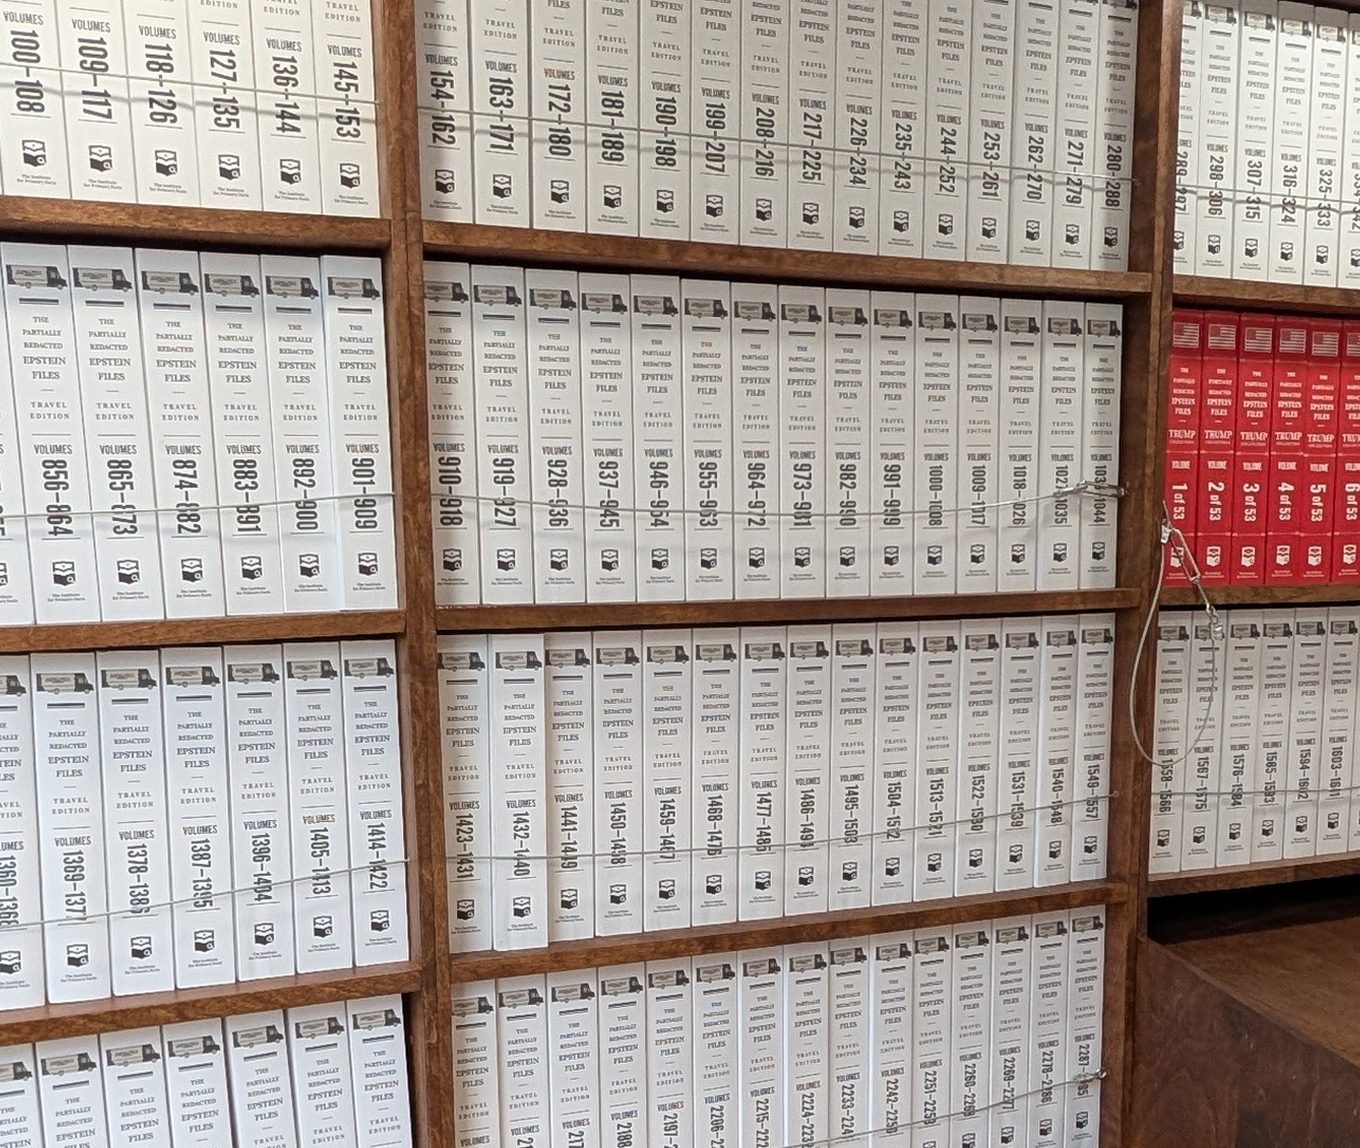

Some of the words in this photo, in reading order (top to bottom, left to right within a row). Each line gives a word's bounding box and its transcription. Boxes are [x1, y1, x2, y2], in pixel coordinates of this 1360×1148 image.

[2, 10, 45, 26] VOLUMES
[703, 5, 732, 18] EPSTEIN
[704, 20, 729, 32] FILES
[701, 47, 730, 60] TRAVEL
[8, 28, 46, 115] 100-108
[701, 61, 731, 73] EDITION
[77, 37, 114, 121] 109-117
[208, 48, 242, 131] 127-135
[700, 86, 731, 101] VOLUMES
[330, 61, 363, 141] 145-153
[428, 68, 457, 147] 154-162
[545, 82, 573, 158] 172-180
[653, 95, 678, 170] 190-198
[702, 101, 728, 174] 199-207
[799, 113, 822, 183] 217-225
[981, 131, 1001, 198] 253-261
[338, 360, 378, 372] EPSTEIN
[346, 373, 373, 385] FILES
[343, 402, 377, 413] TRAVEL
[343, 413, 379, 423] EDITION
[345, 442, 380, 455] VOLUMES
[433, 441, 465, 455] VOLUMES
[40, 457, 76, 538] 856-864
[292, 457, 321, 533] 892-900
[351, 457, 379, 531] 901-909
[455, 1066, 490, 1077] EPSTEIN
[462, 1078, 484, 1088] FILES
